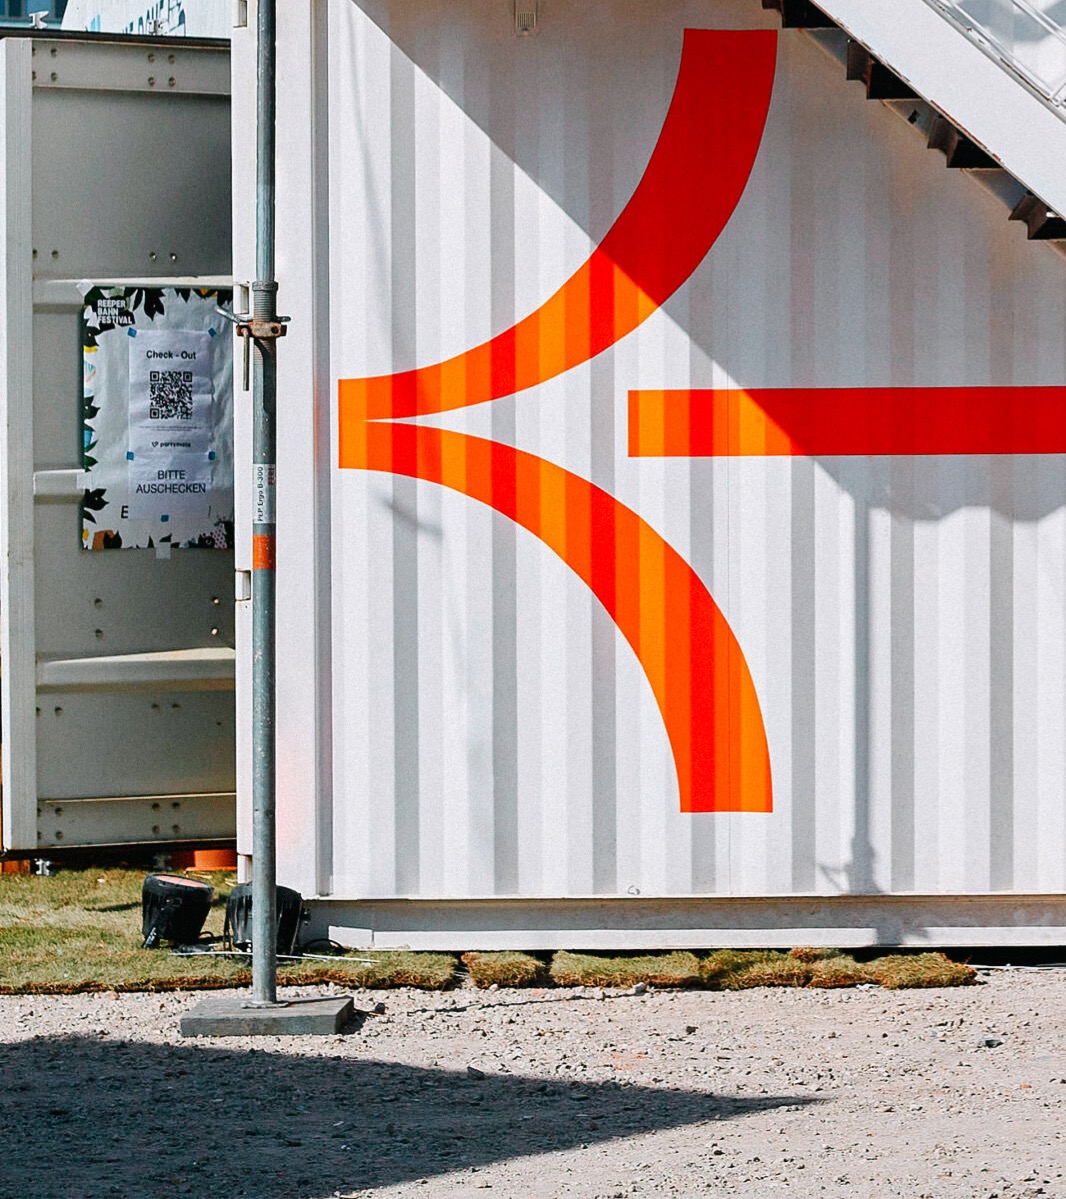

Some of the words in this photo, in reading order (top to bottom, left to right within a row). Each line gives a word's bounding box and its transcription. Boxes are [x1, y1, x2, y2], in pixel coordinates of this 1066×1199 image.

[97, 299, 126, 308] REEPER
[97, 315, 132, 324] FESTIVAL
[146, 350, 174, 359] Check
[181, 350, 196, 360] Out
[157, 469, 186, 480] BITTE
[135, 483, 206, 494] AUSCHECKEN
